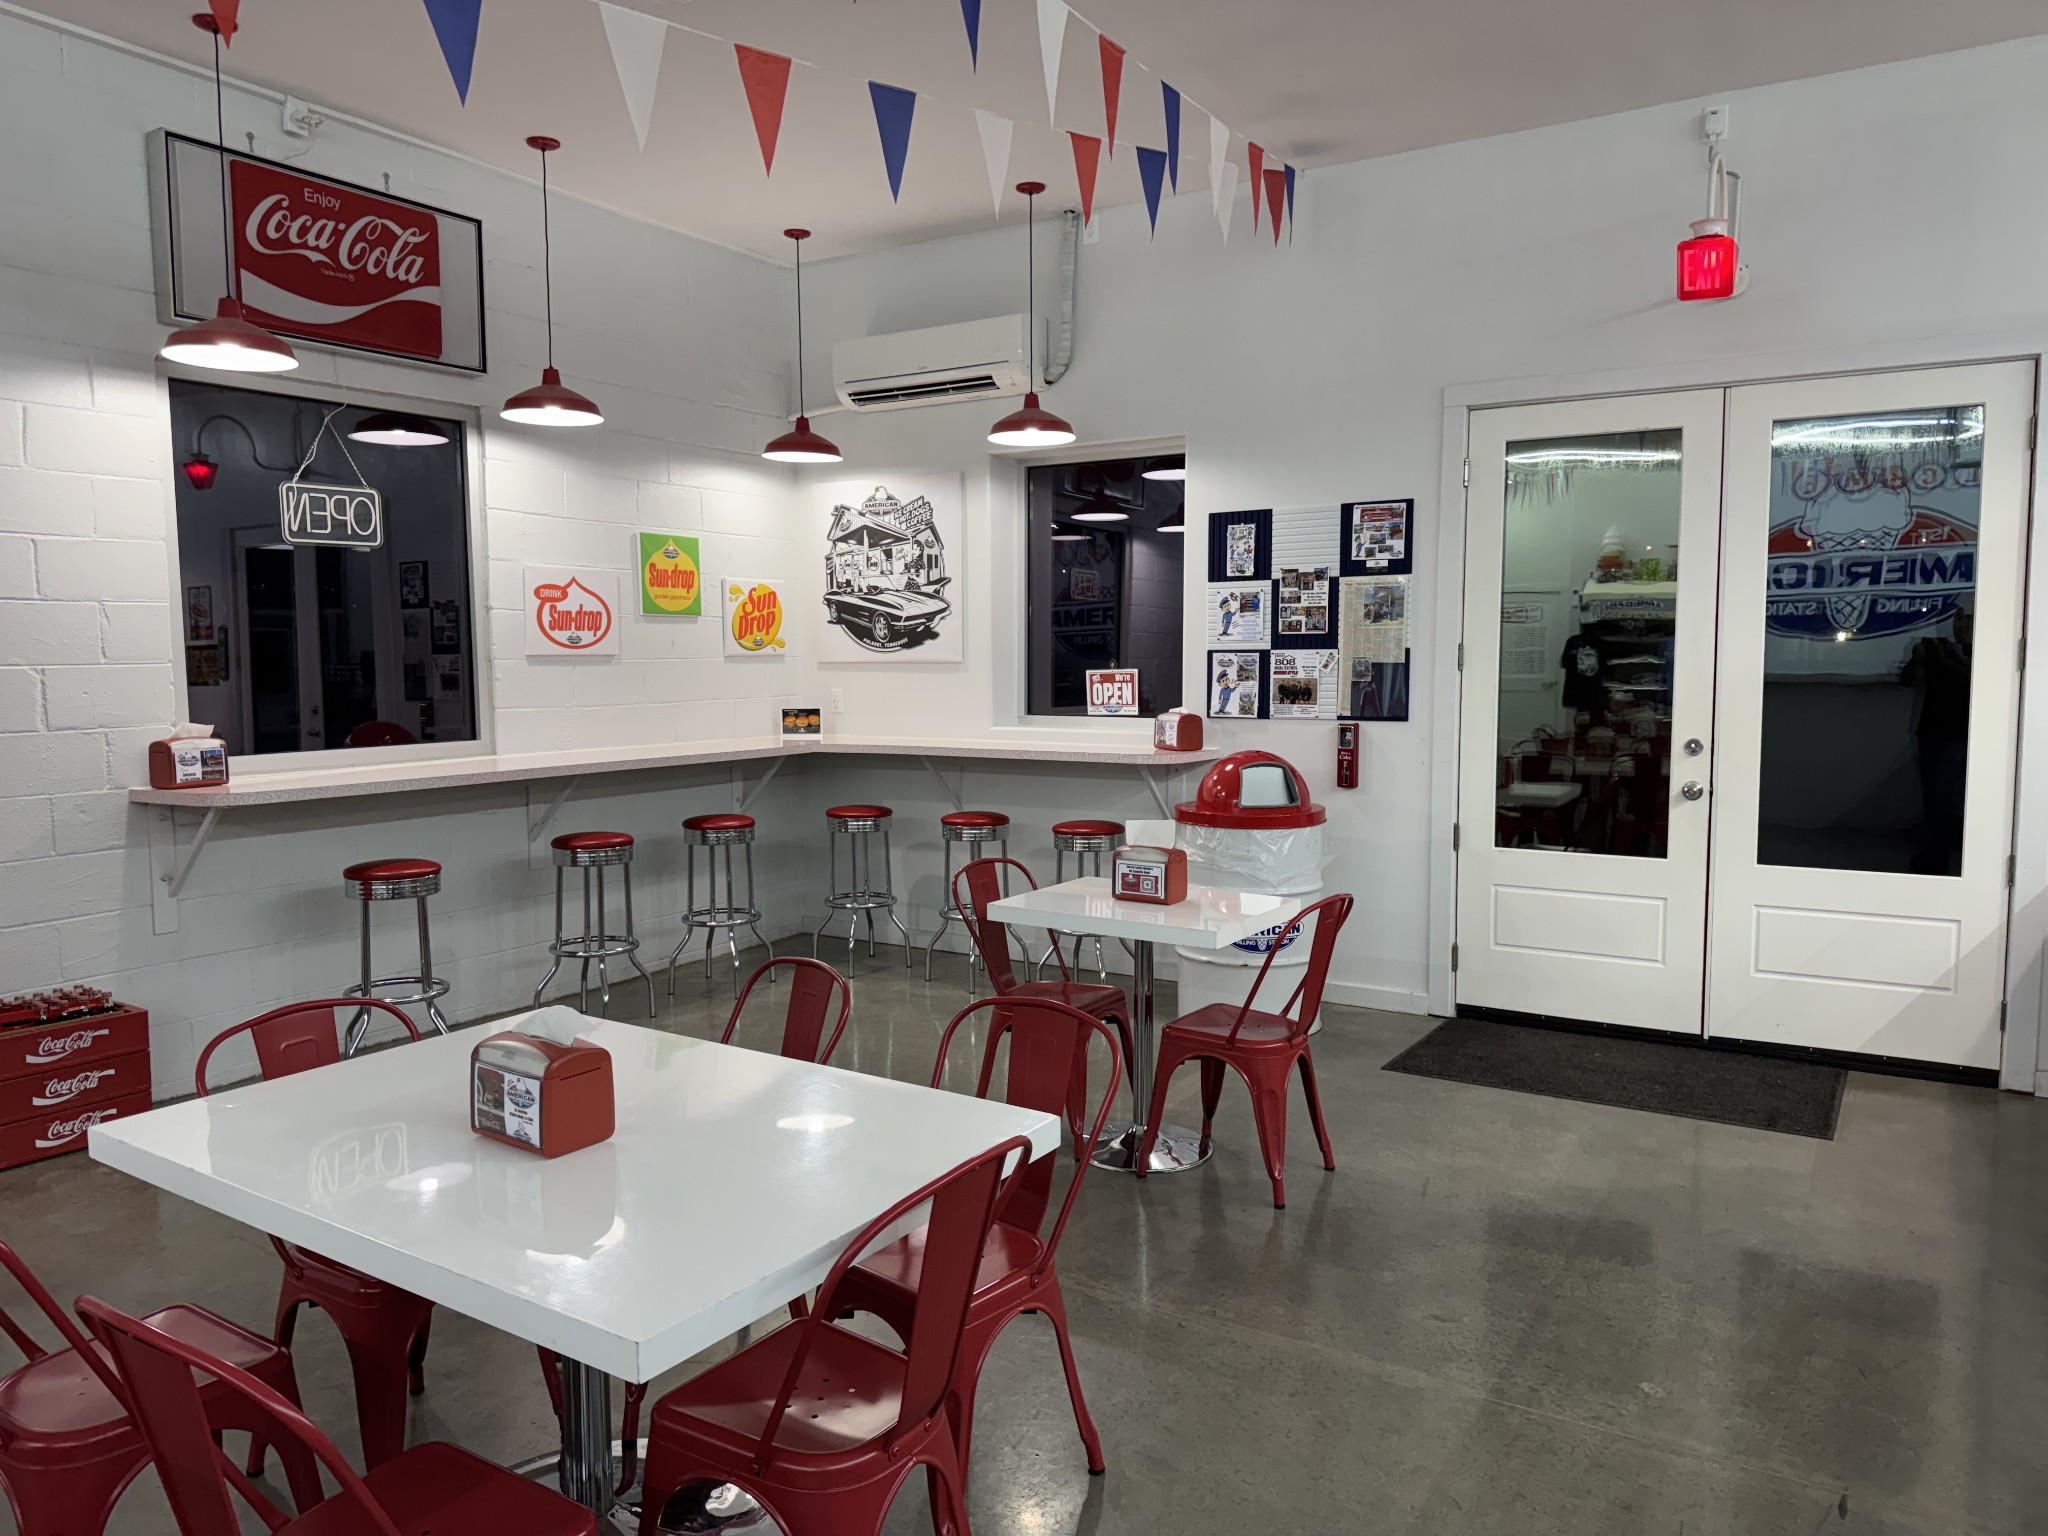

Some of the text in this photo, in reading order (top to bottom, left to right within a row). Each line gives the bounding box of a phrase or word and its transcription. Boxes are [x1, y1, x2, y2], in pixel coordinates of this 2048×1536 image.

[303, 187, 341, 210] Enjoy
[245, 193, 430, 284] Coca-Cola
[1683, 249, 1724, 291] EXIT
[864, 501, 898, 509] AMERICAN
[911, 503, 930, 518] DOGS
[906, 509, 932, 527] COFFEE
[648, 562, 695, 594] Sun-drop
[540, 588, 563, 598] DRINK
[742, 587, 777, 616] Sun
[548, 603, 603, 637] Sun-drop
[737, 610, 776, 641] Drop
[1274, 658, 1296, 666] 808
[1114, 673, 1131, 682] We're
[1092, 682, 1133, 705] OPEN
[39, 1028, 94, 1056] Coca-Cola
[45, 1069, 100, 1098] Coca-Cola
[506, 1089, 536, 1103] AMERICAN
